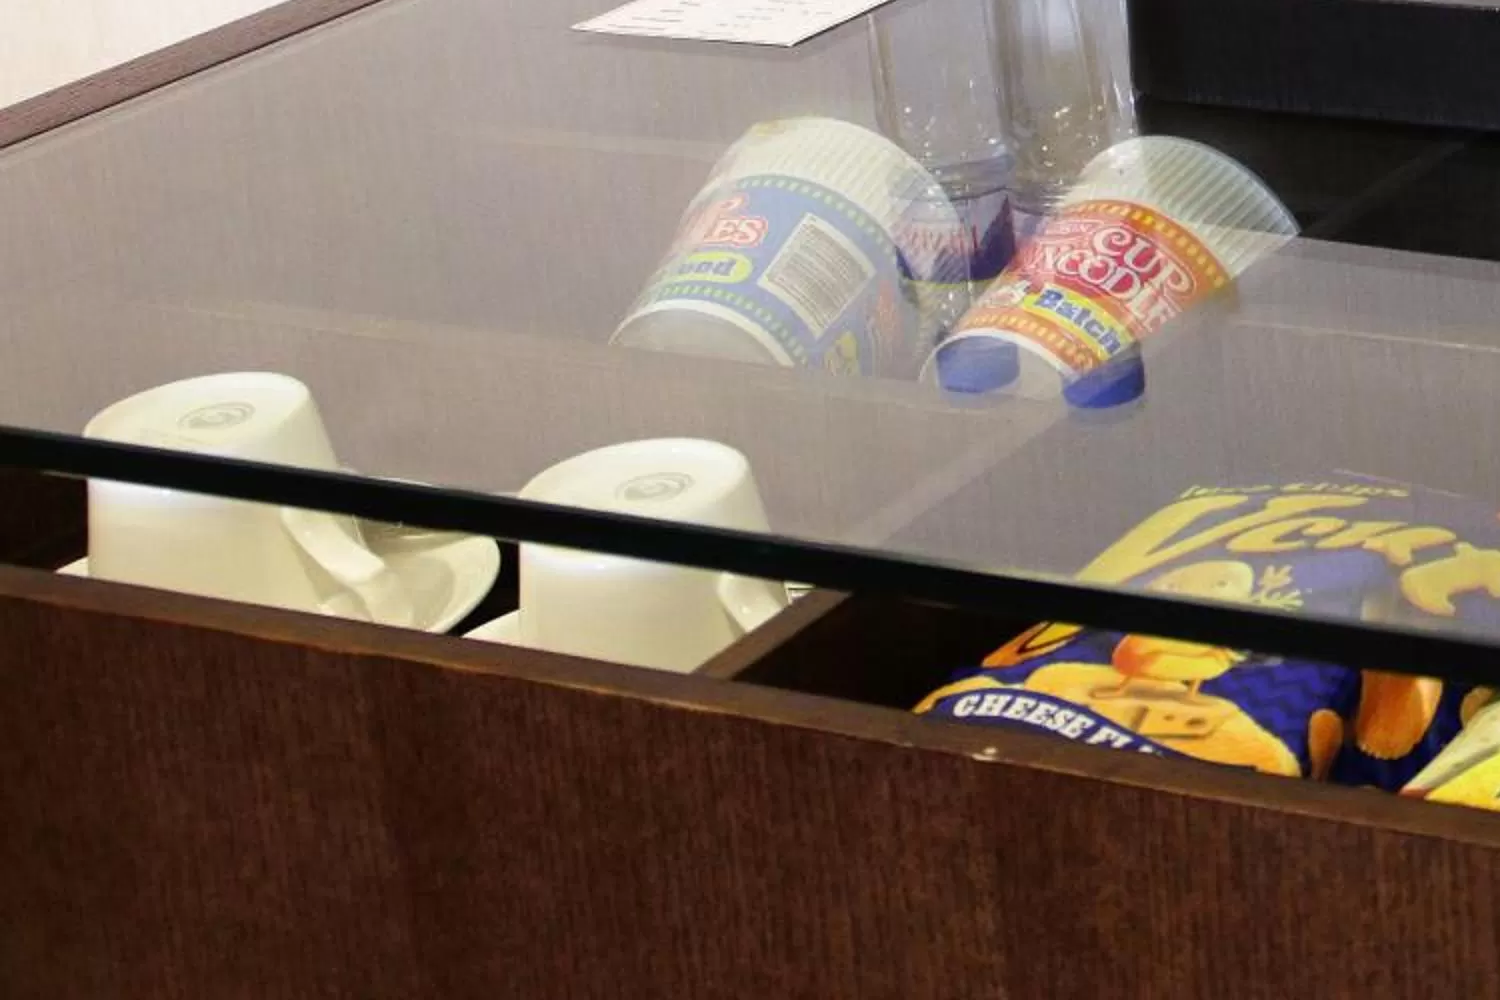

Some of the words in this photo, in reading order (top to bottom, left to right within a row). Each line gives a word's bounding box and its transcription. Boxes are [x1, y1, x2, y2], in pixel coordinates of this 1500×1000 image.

[1037, 240, 1179, 333] NOODLE
[1092, 225, 1193, 295] CUP
[953, 692, 1096, 740] CHEESE
